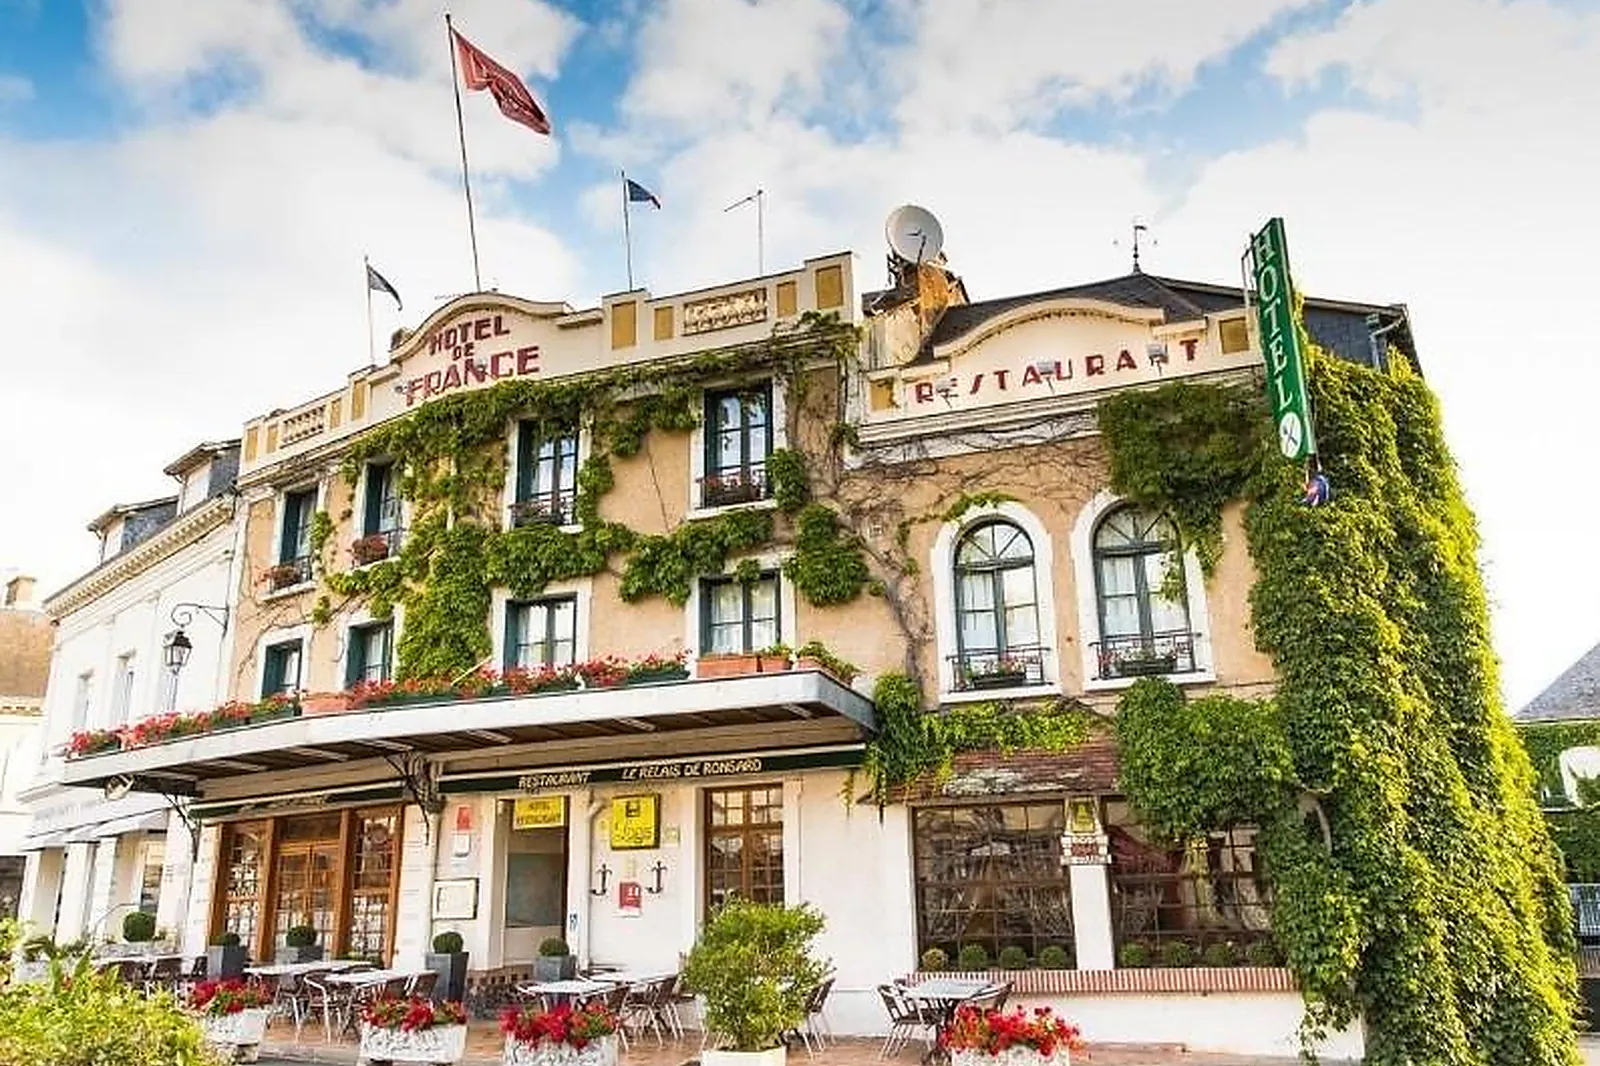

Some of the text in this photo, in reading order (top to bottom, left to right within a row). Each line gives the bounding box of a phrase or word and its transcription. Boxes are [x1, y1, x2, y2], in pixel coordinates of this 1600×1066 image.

[428, 315, 511, 356] HOTEL
[1254, 228, 1294, 412] HOTEL
[452, 342, 475, 361] DE
[914, 337, 1199, 404] RESTAURAT
[405, 345, 540, 407] FRANCE
[518, 772, 591, 788] RESTAURANT
[621, 758, 762, 780] LE RELAIS DE RONSARD
